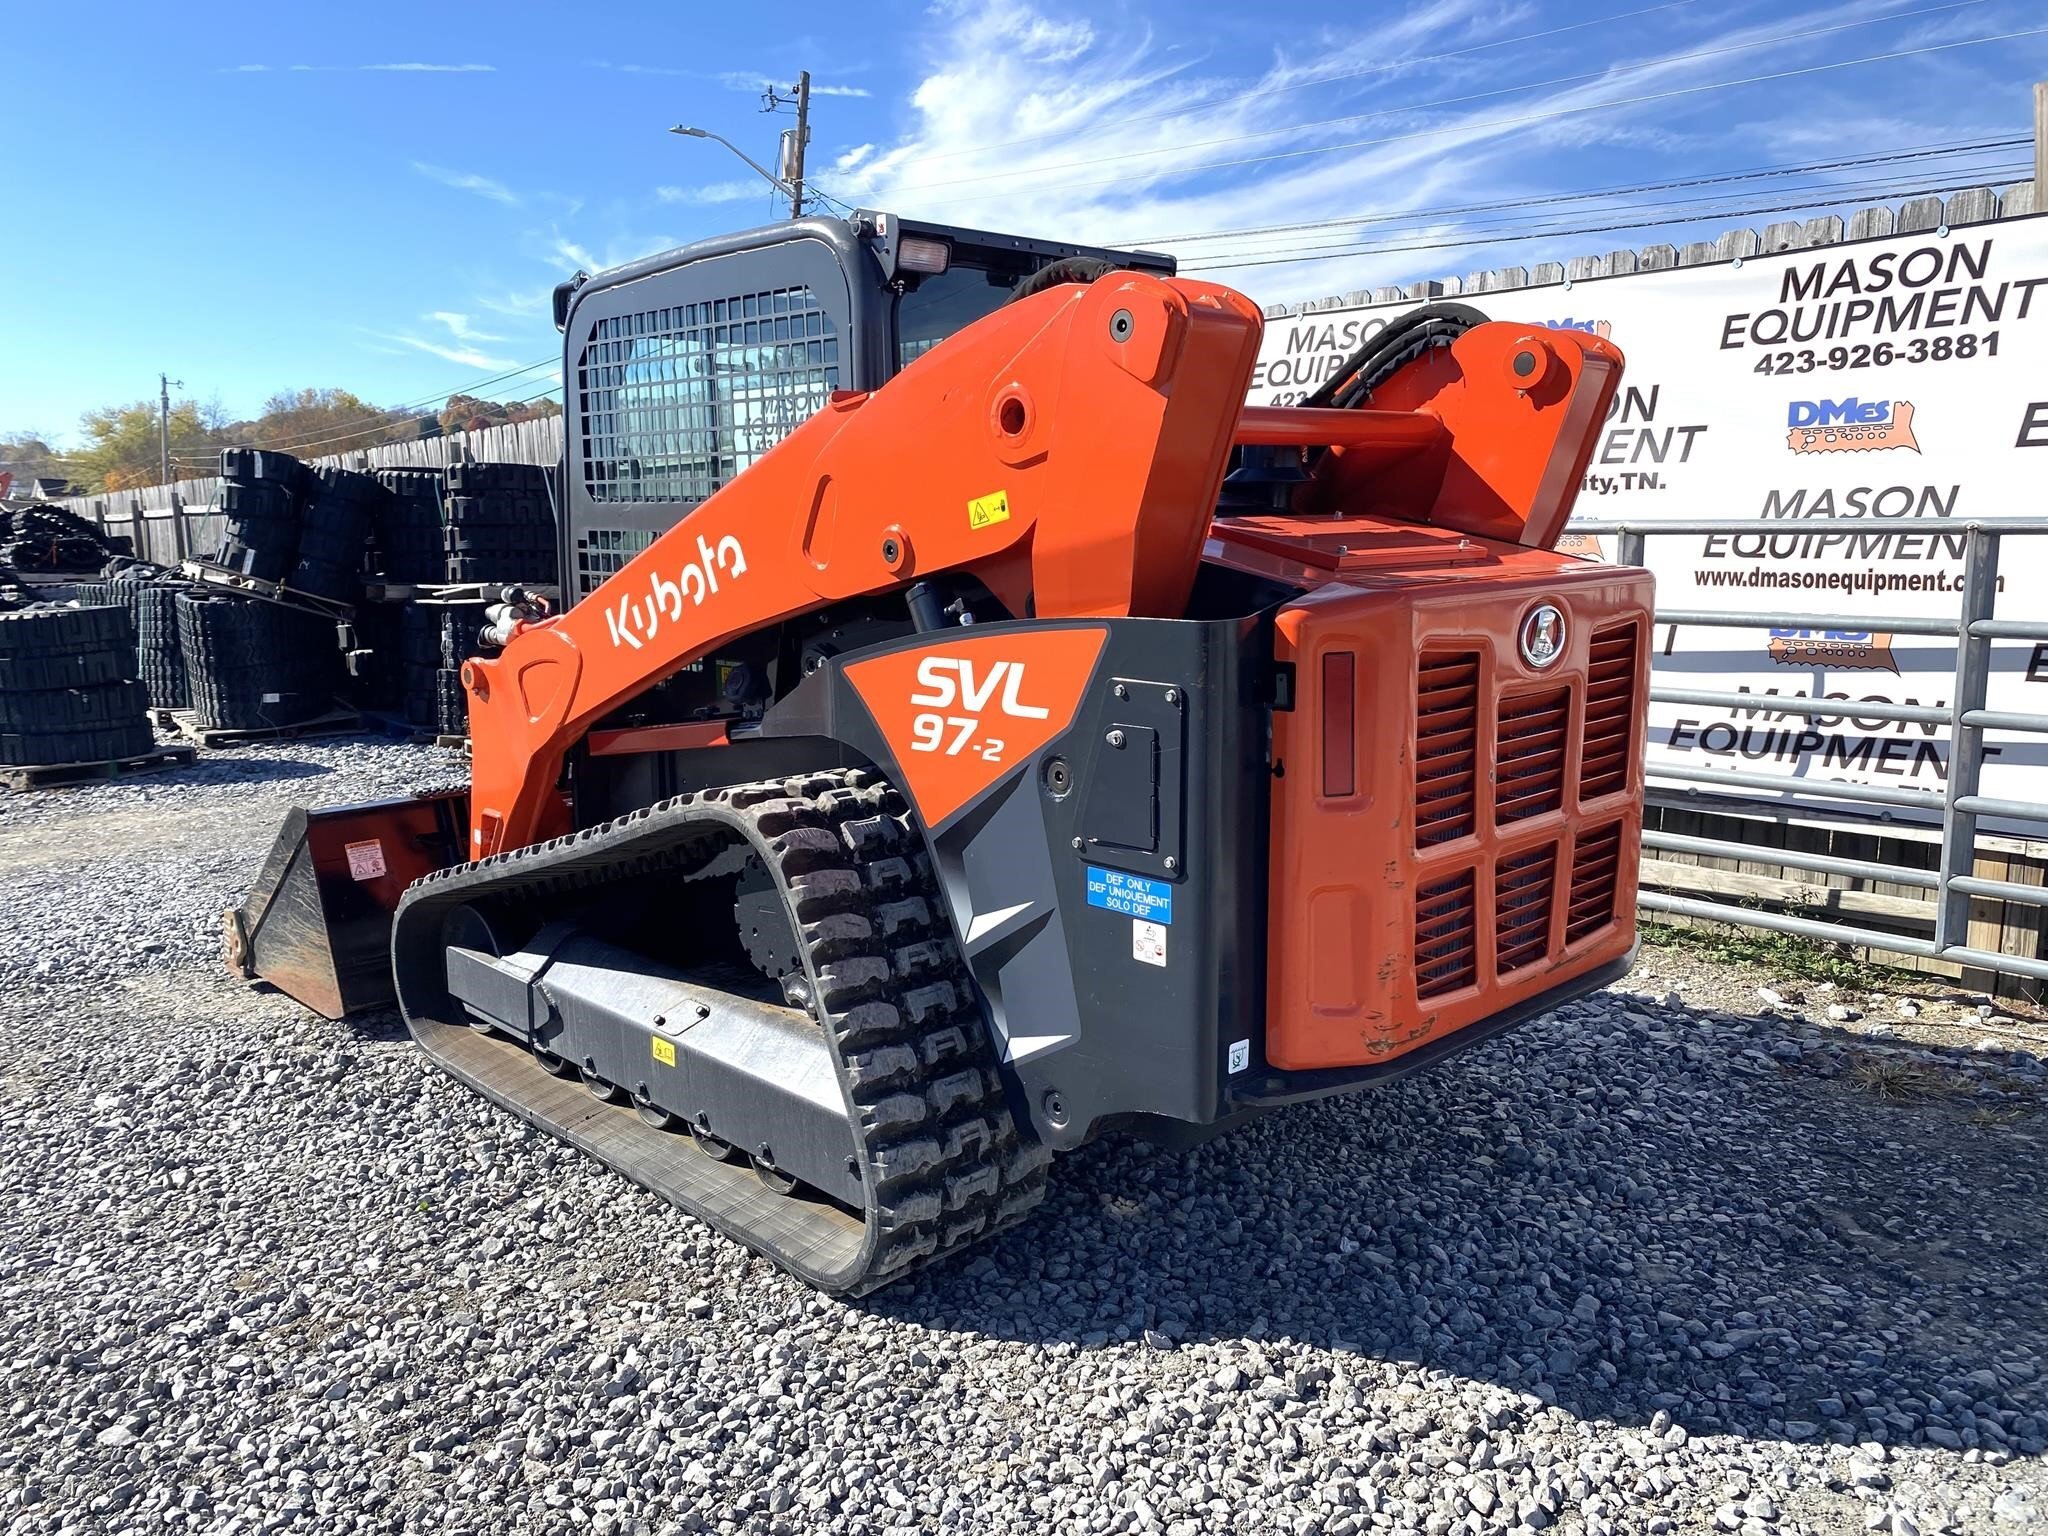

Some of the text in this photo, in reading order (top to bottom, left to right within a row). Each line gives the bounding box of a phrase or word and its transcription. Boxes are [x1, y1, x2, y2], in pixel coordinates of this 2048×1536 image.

[1779, 239, 1994, 304] MASON
[1719, 277, 2048, 350] EQUIPMENT
[1286, 317, 1387, 355] MASO
[1753, 330, 2000, 376] 423-926-3881
[1760, 484, 1960, 519] MASON
[605, 534, 748, 650] Kubota
[1694, 566, 2005, 596] www.dmasonequipment.c
[910, 656, 1050, 720] SVL
[911, 713, 1005, 762] 97-2
[1089, 880, 1169, 909] DEF UNIQUEMENT
[1106, 873, 1151, 893] DEF ONLY
[1106, 897, 1151, 916] SOLO DEF
